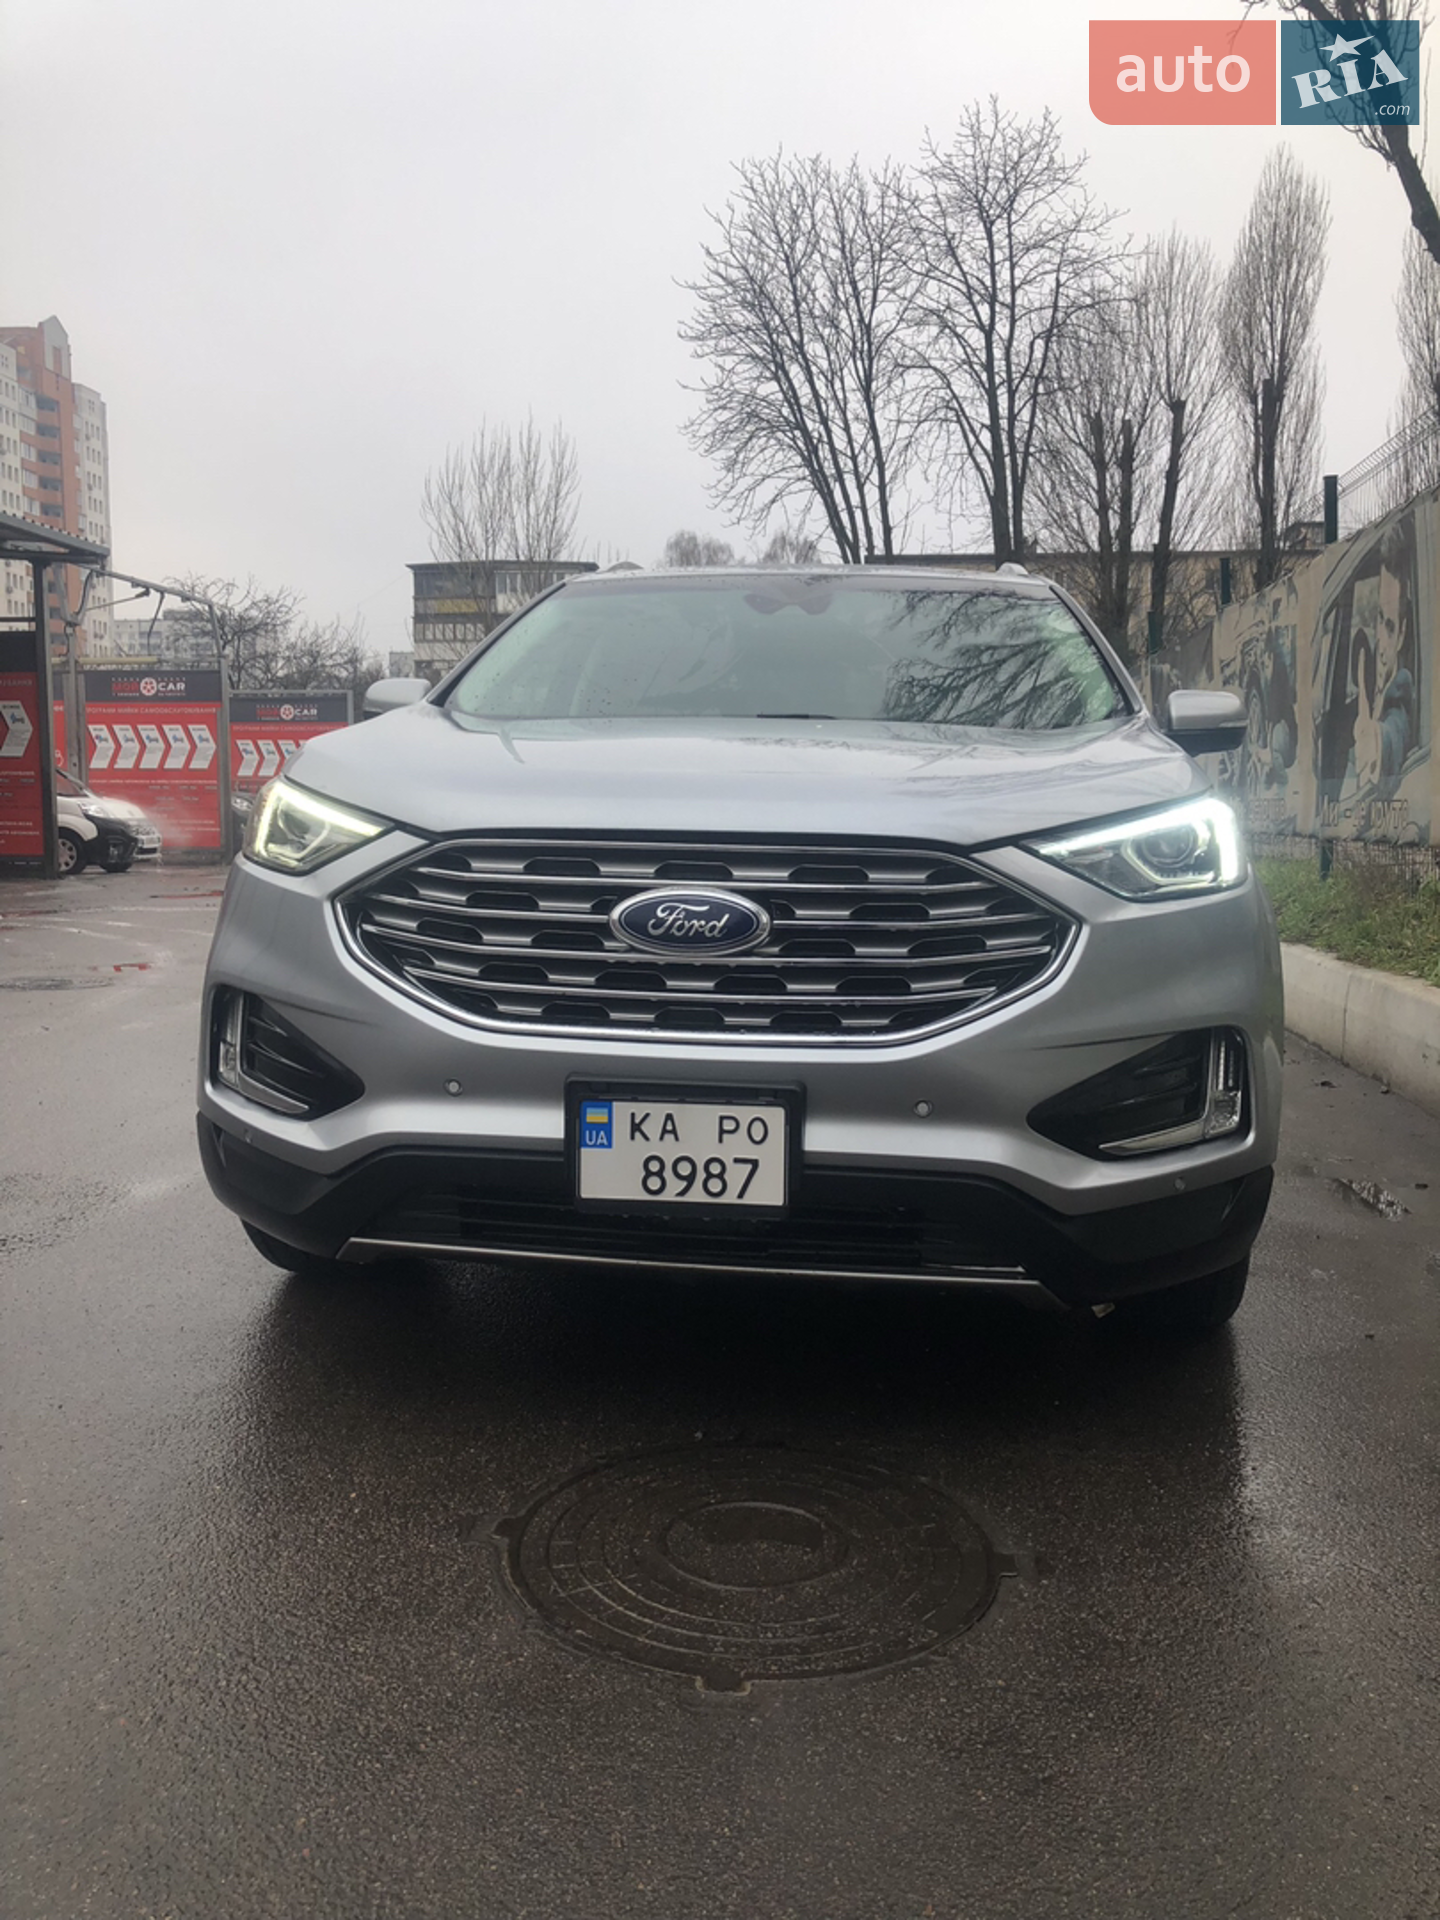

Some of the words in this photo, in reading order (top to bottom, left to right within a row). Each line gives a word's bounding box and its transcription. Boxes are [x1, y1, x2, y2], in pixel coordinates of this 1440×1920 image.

[158, 682, 186, 691] CAR
[647, 902, 730, 938] Ford
[585, 1130, 609, 1146] UA
[629, 1112, 680, 1142] KA
[717, 1115, 769, 1145] PO
[641, 1154, 760, 1199] 8987
